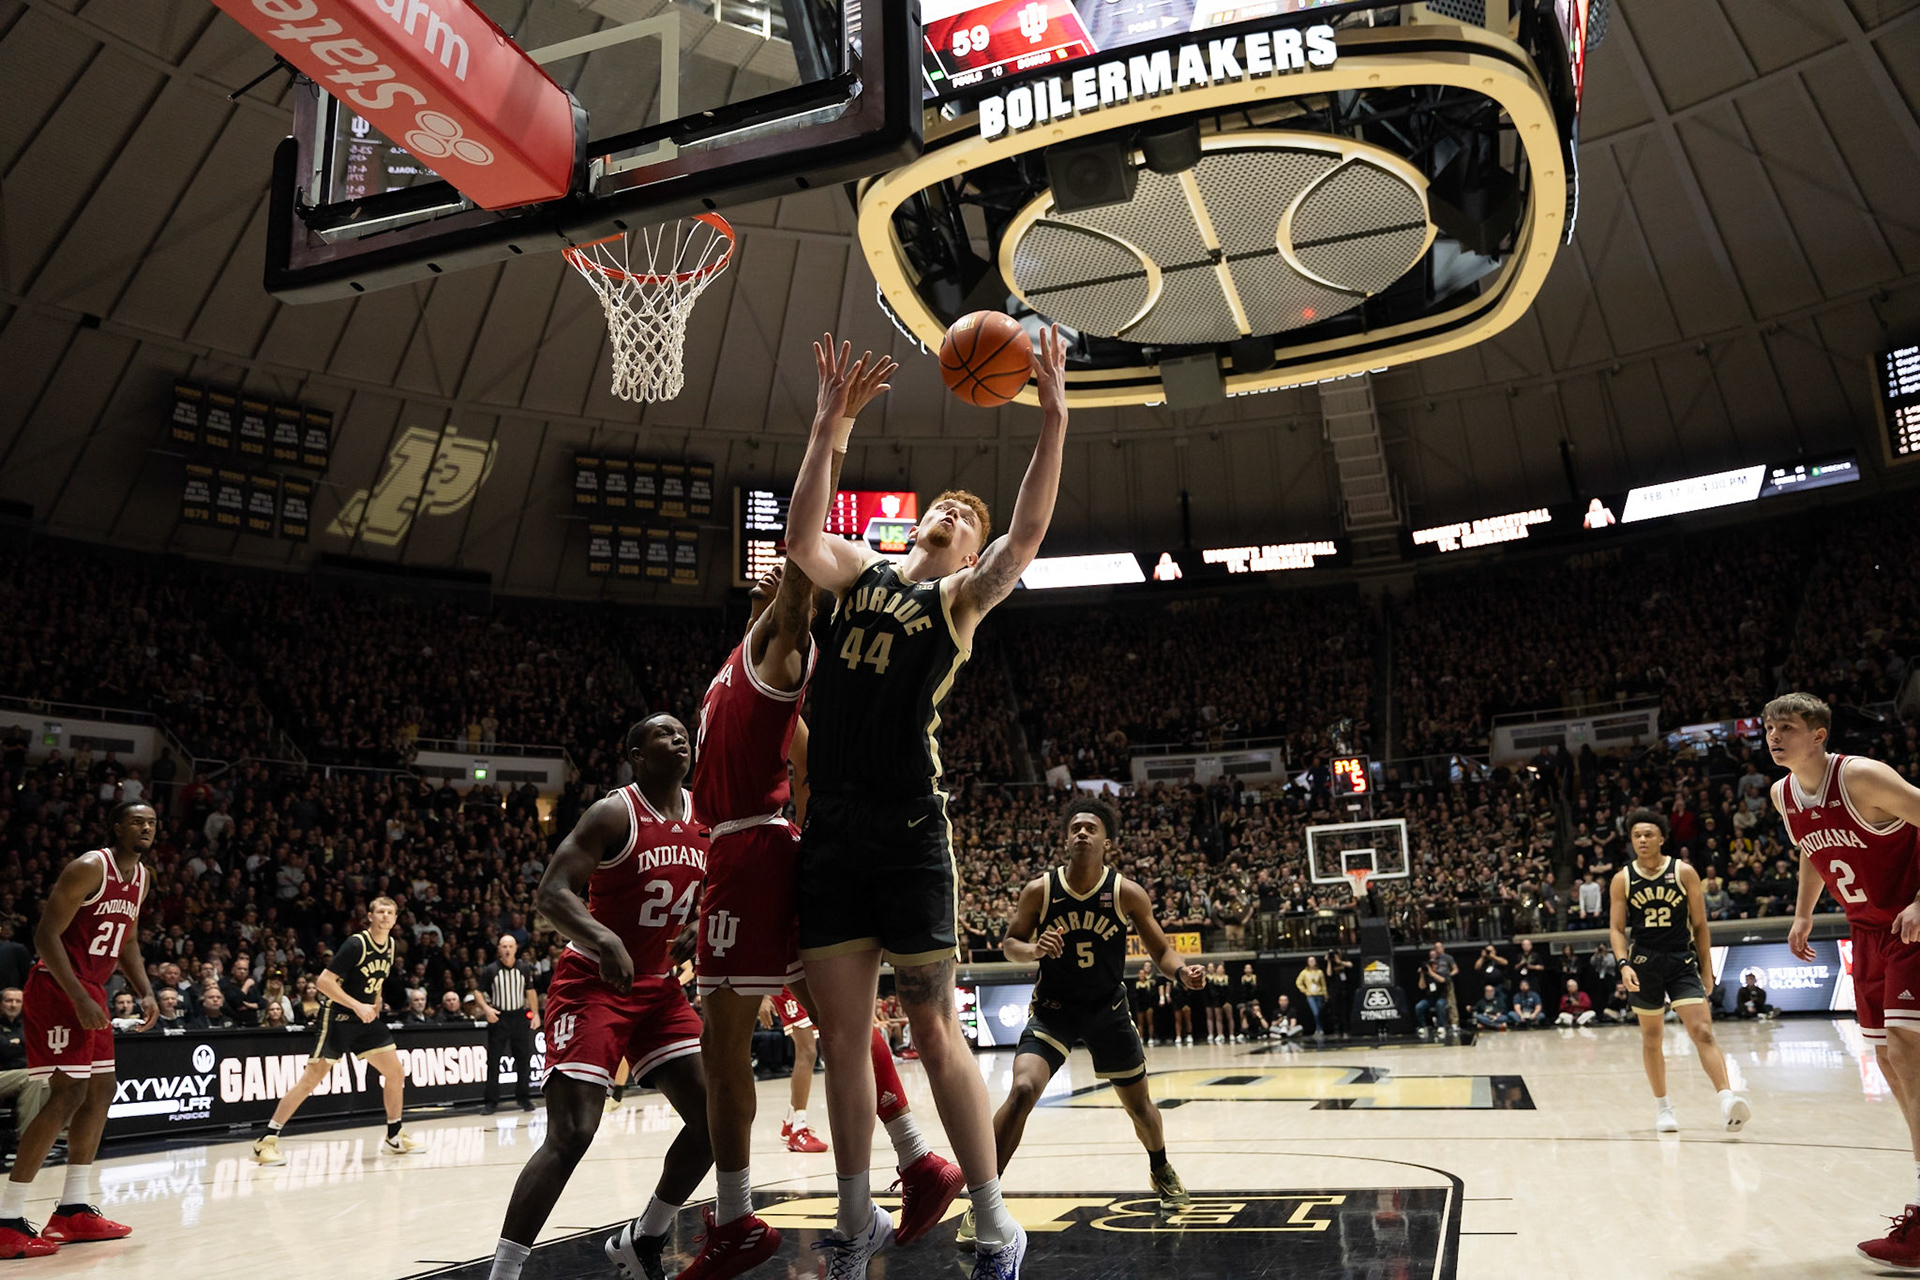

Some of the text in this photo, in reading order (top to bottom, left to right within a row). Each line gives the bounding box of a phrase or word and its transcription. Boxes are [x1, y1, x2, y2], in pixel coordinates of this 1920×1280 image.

[951, 24, 990, 57] 59
[252, 0, 427, 110] State
[979, 24, 1338, 140] BOILERMAKERS
[1472, 507, 1552, 531] BASKETBALL
[1262, 541, 1337, 559] BASKETBALL
[1461, 525, 1529, 549] NEBRASKA
[1250, 555, 1315, 572] NEBRASKA
[844, 587, 933, 637] PURDUE
[840, 626, 894, 675] 44
[1351, 770, 1366, 792] 5
[1799, 829, 1868, 858] INDIANA
[1830, 859, 1868, 904] 2
[639, 879, 700, 928] 24
[1630, 886, 1684, 910] PURDUE
[1644, 906, 1672, 928] 22
[89, 921, 127, 958] 21
[1076, 941, 1095, 969] 5
[1767, 965, 1829, 981] PURDUE
[1769, 978, 1819, 990] GLOBAL
[379, 1045, 488, 1090] PONSOR
[169, 1111, 210, 1122] FUNGICIDE
[179, 1096, 212, 1112] LFR
